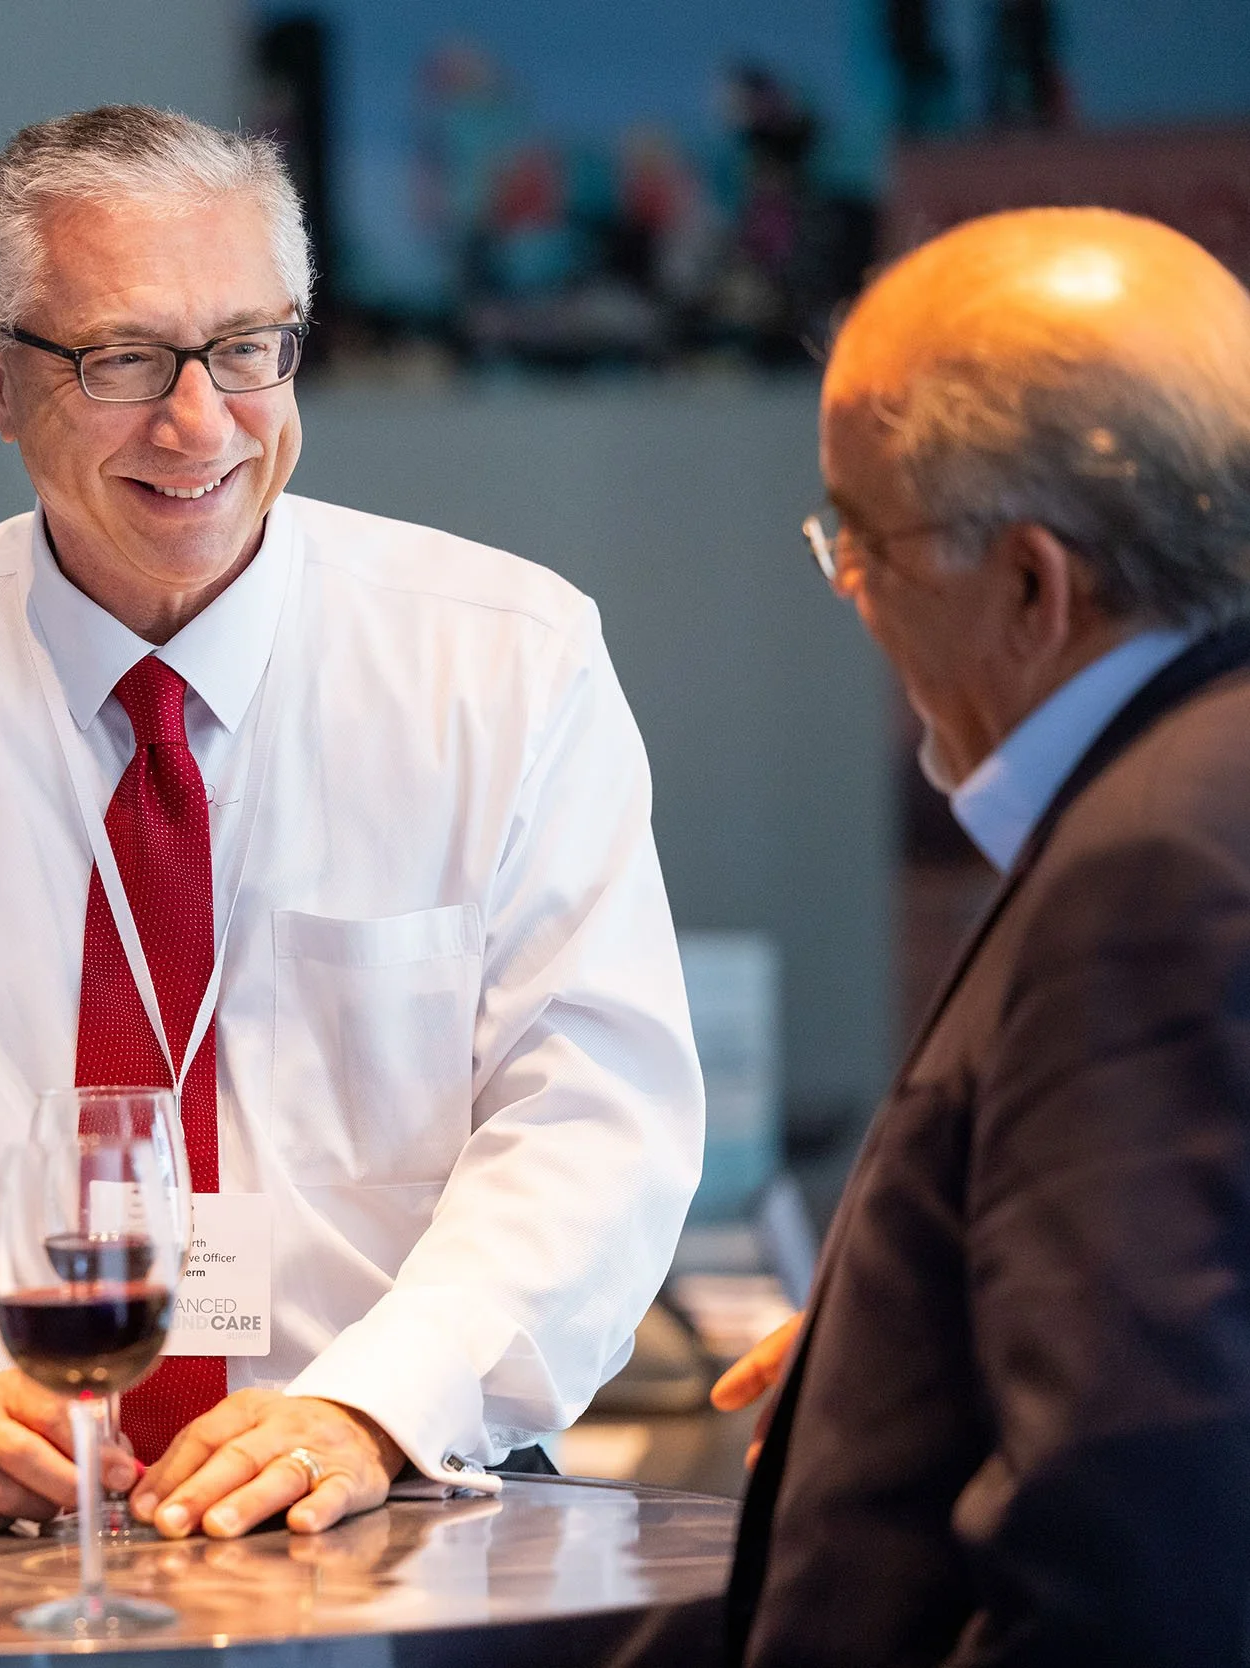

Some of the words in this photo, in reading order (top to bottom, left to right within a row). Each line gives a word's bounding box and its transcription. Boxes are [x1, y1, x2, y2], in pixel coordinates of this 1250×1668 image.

[189, 1238, 206, 1248] rth
[202, 1253, 237, 1263] Officer
[182, 1268, 206, 1277] erm
[172, 1297, 237, 1314] ANCED
